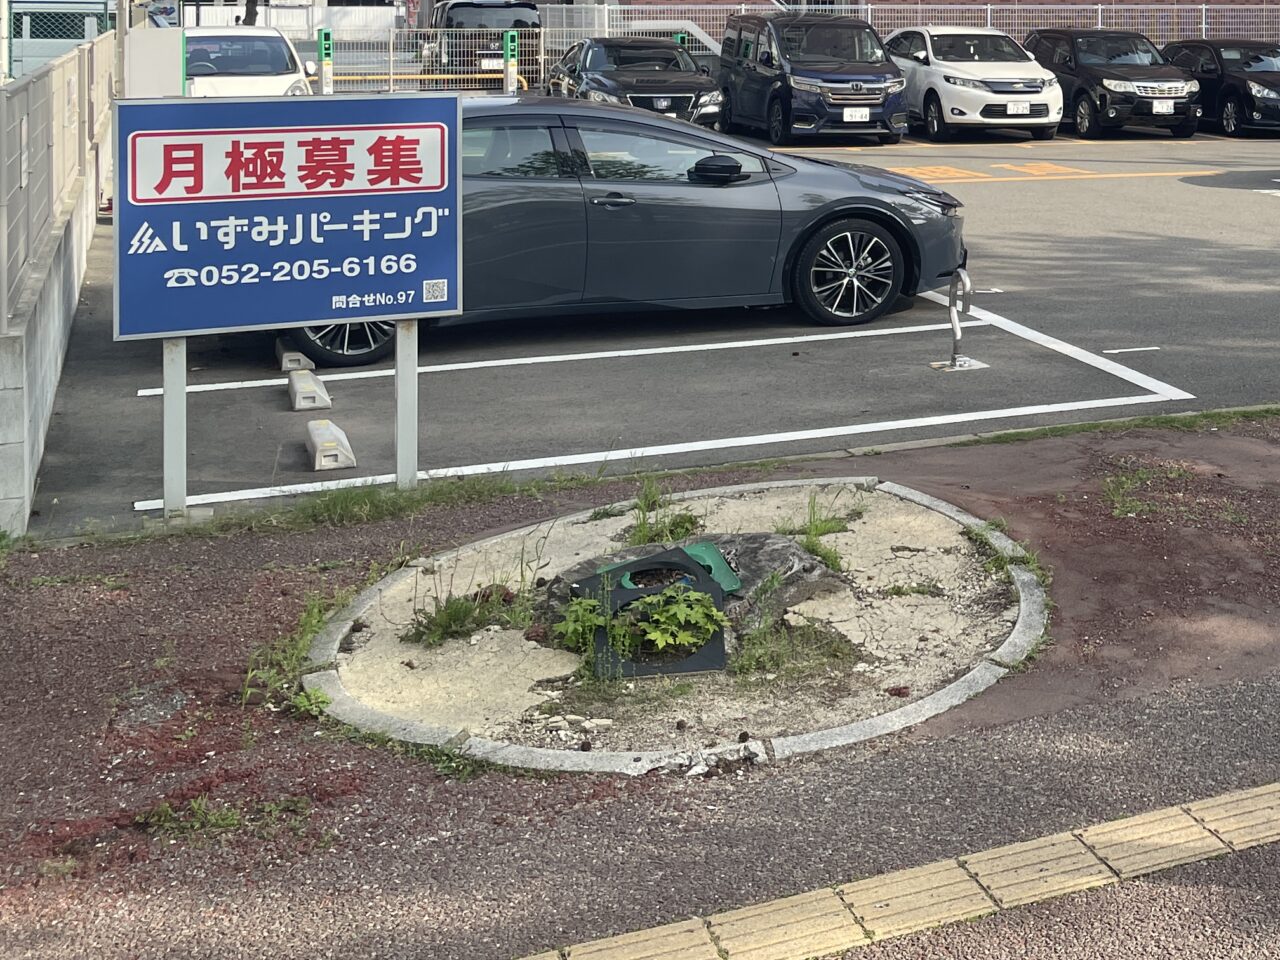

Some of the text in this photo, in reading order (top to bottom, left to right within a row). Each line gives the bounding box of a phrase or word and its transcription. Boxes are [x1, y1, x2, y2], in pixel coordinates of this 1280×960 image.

[153, 135, 423, 196] 月極募集
[172, 206, 449, 252] いずみパーキング
[200, 253, 417, 286] 052-205-6166
[332, 290, 416, 309] 問合せNo.97
